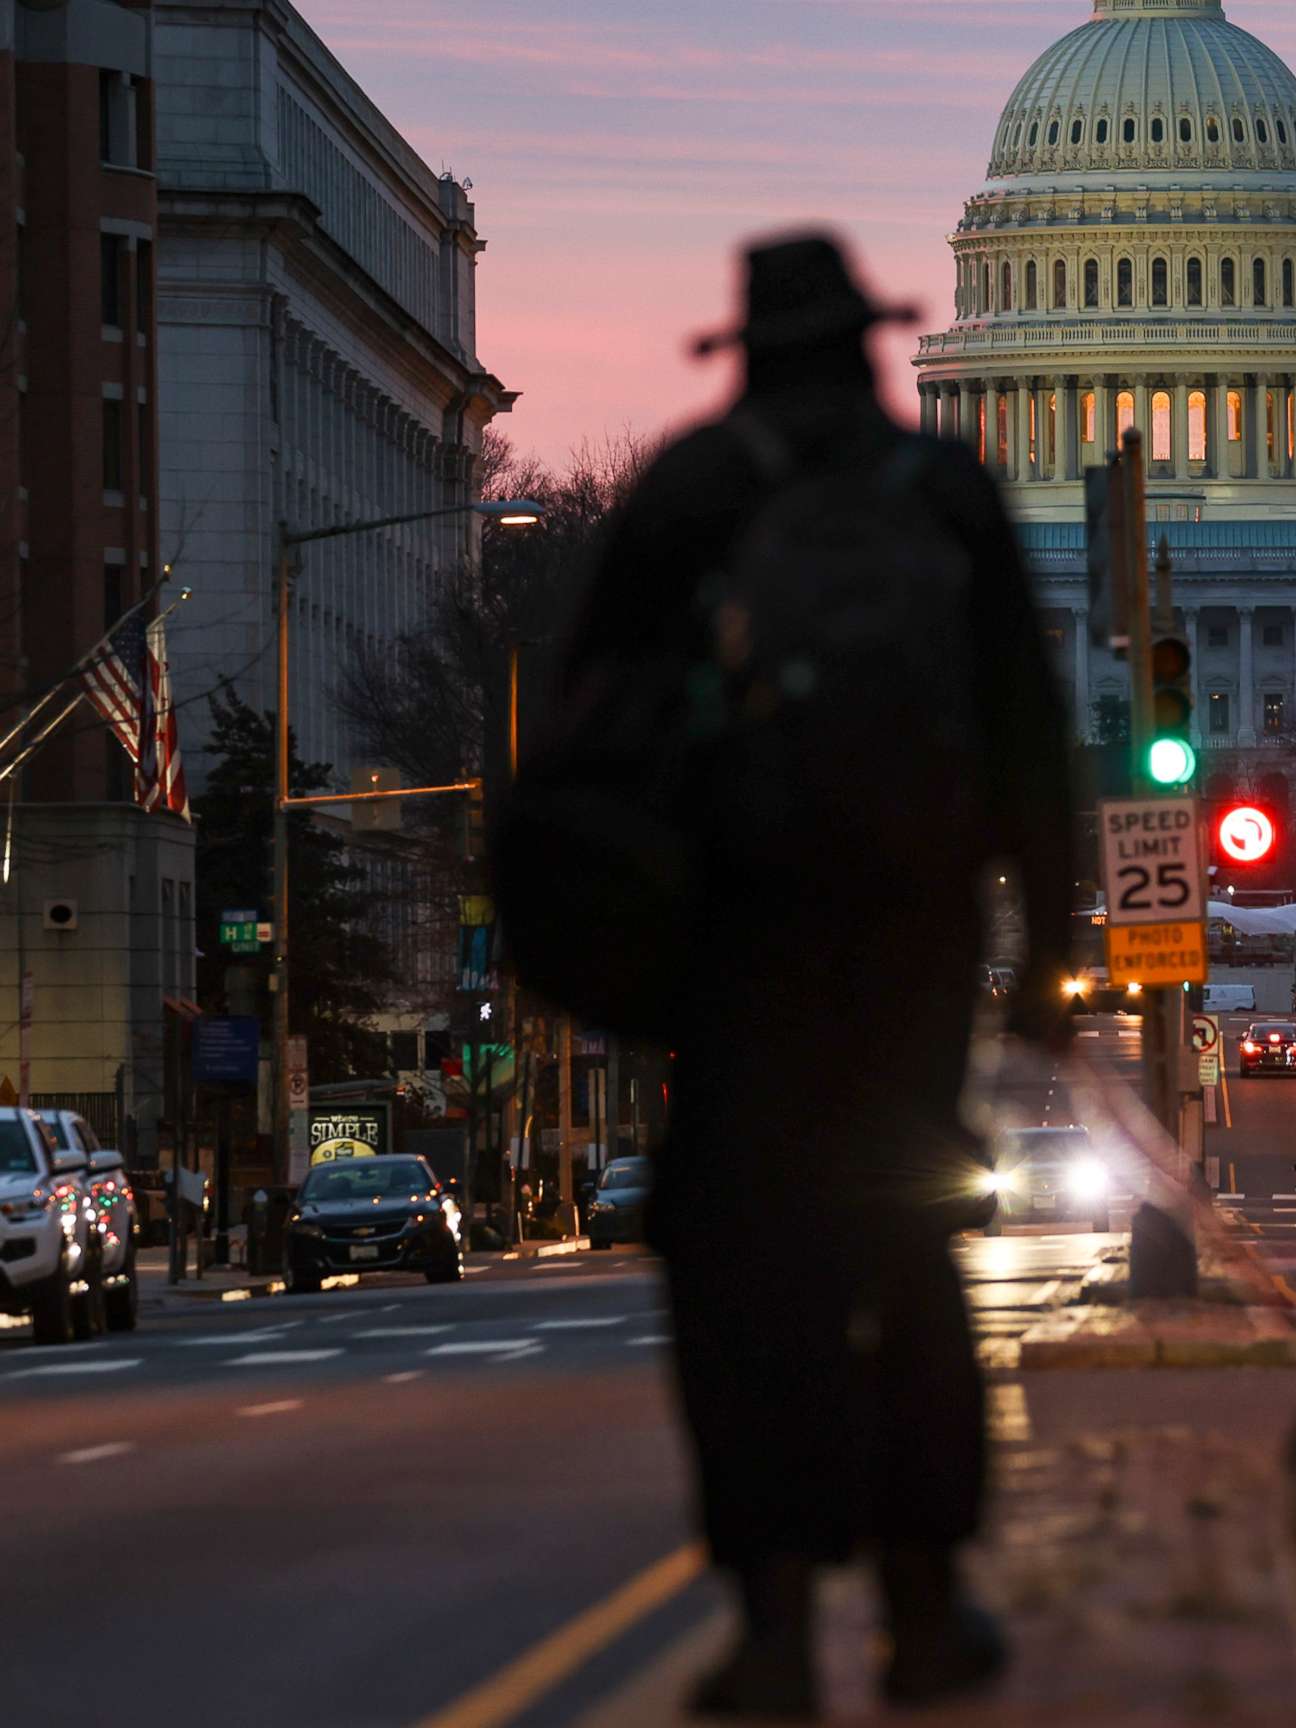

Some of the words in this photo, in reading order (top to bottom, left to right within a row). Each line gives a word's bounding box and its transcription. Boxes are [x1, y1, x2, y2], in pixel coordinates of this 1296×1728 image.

[1109, 810, 1190, 833] SPEED
[1118, 837, 1181, 859] LIMIT
[1117, 863, 1189, 910] 25
[225, 925, 238, 941] H
[1128, 926, 1184, 945] PHOTO
[1114, 950, 1199, 971] ENFORCED
[311, 1122, 378, 1145] SIMPLE
